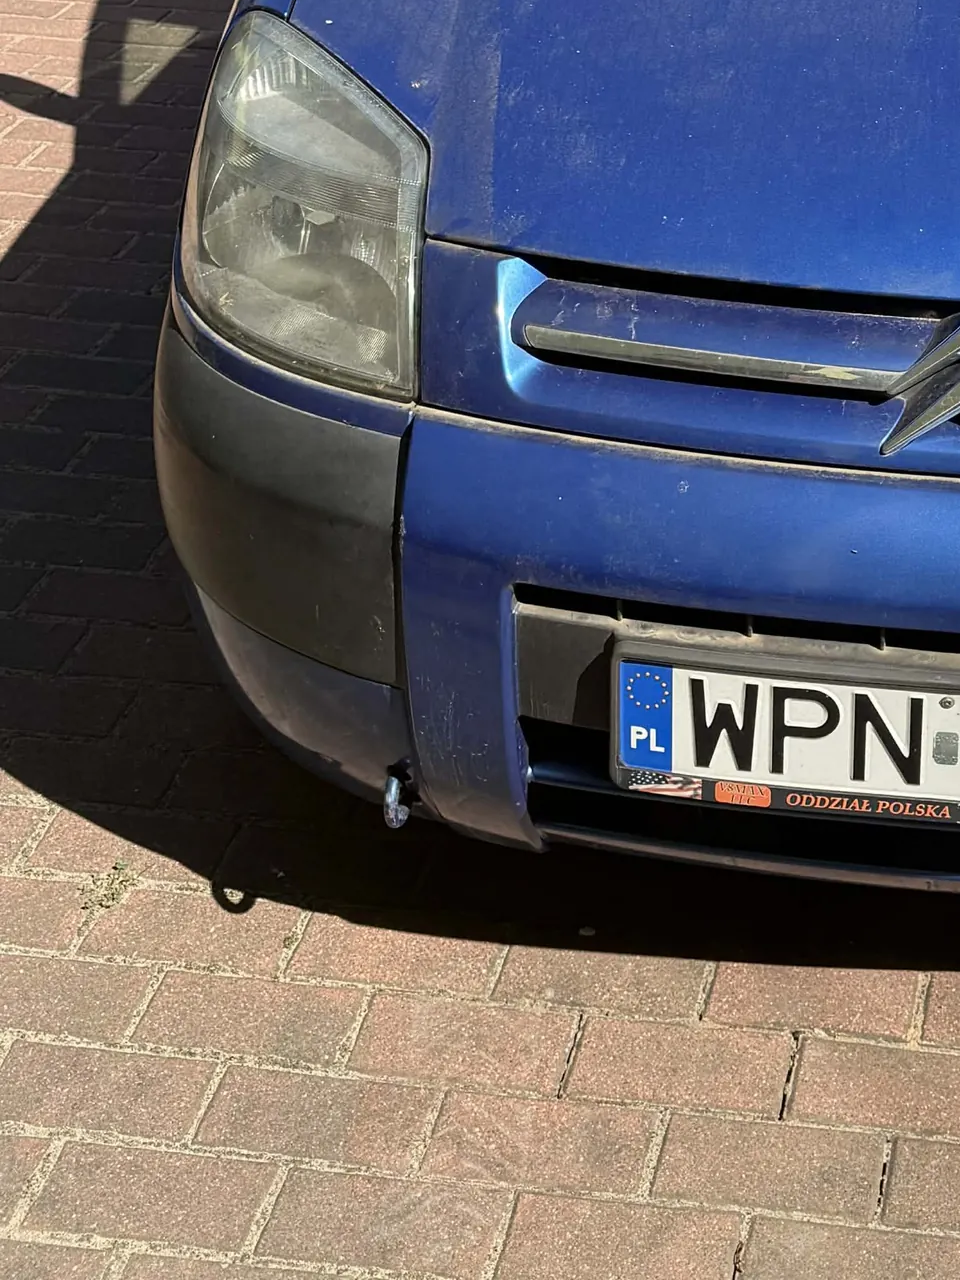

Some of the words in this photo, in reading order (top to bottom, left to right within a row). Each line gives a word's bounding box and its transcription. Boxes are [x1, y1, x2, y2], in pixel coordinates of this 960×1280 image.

[630, 725, 665, 753] PL
[688, 677, 924, 786] WPN
[784, 793, 872, 813] ODDZIAŁ
[875, 799, 952, 819] POLSKA
